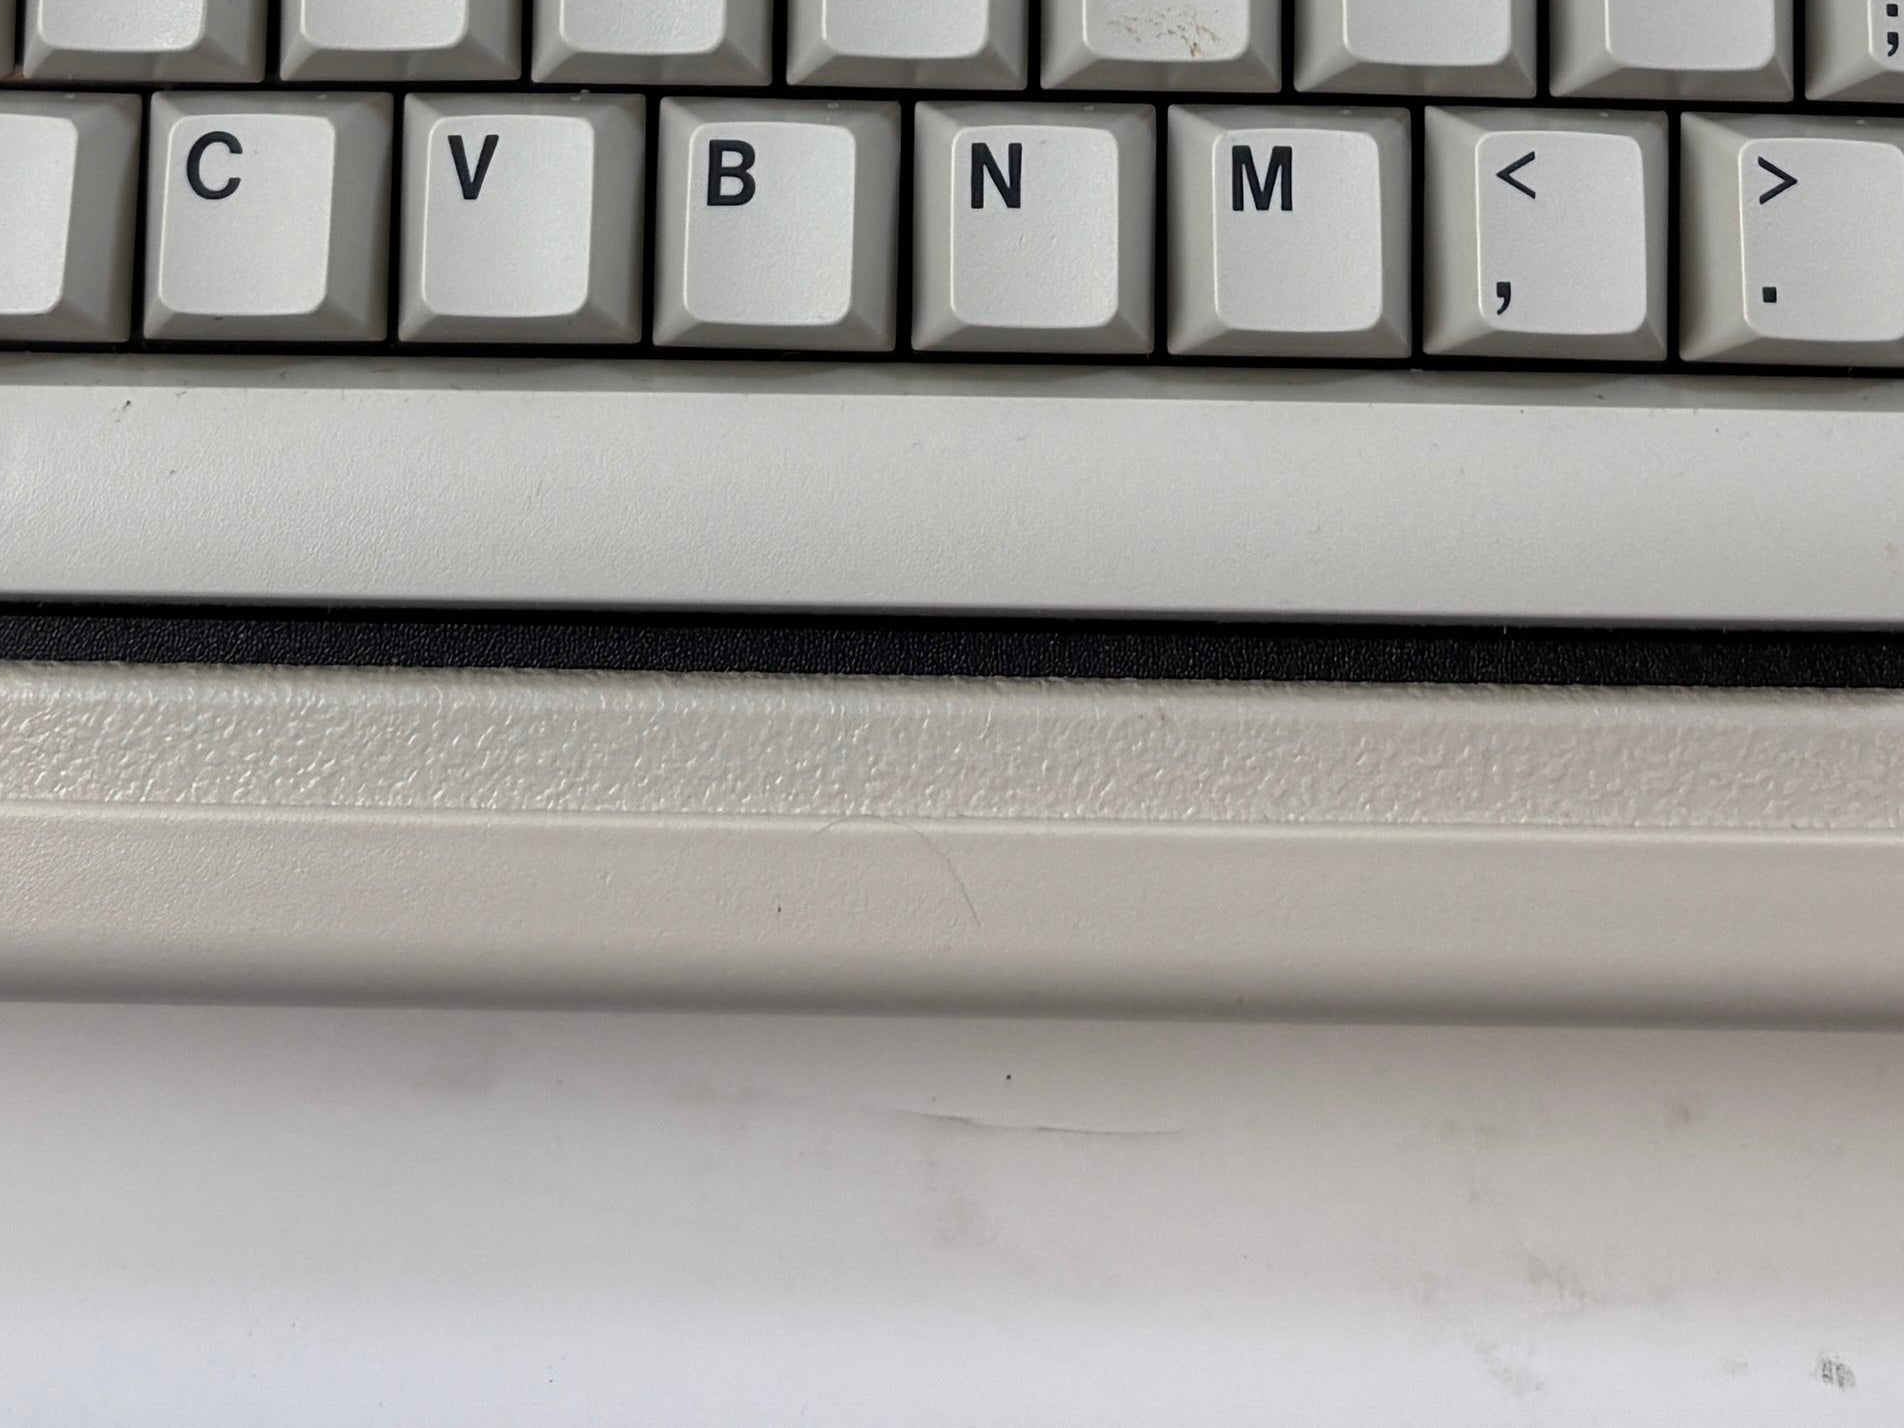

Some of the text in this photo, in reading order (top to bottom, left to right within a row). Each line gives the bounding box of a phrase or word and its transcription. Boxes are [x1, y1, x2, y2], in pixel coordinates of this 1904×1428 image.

[186, 131, 242, 200] C
[448, 135, 499, 200] V
[707, 140, 755, 206] B
[971, 143, 1022, 209] N
[1232, 146, 1292, 211] M
[1496, 152, 1535, 199] <
[1758, 157, 1797, 204] >
